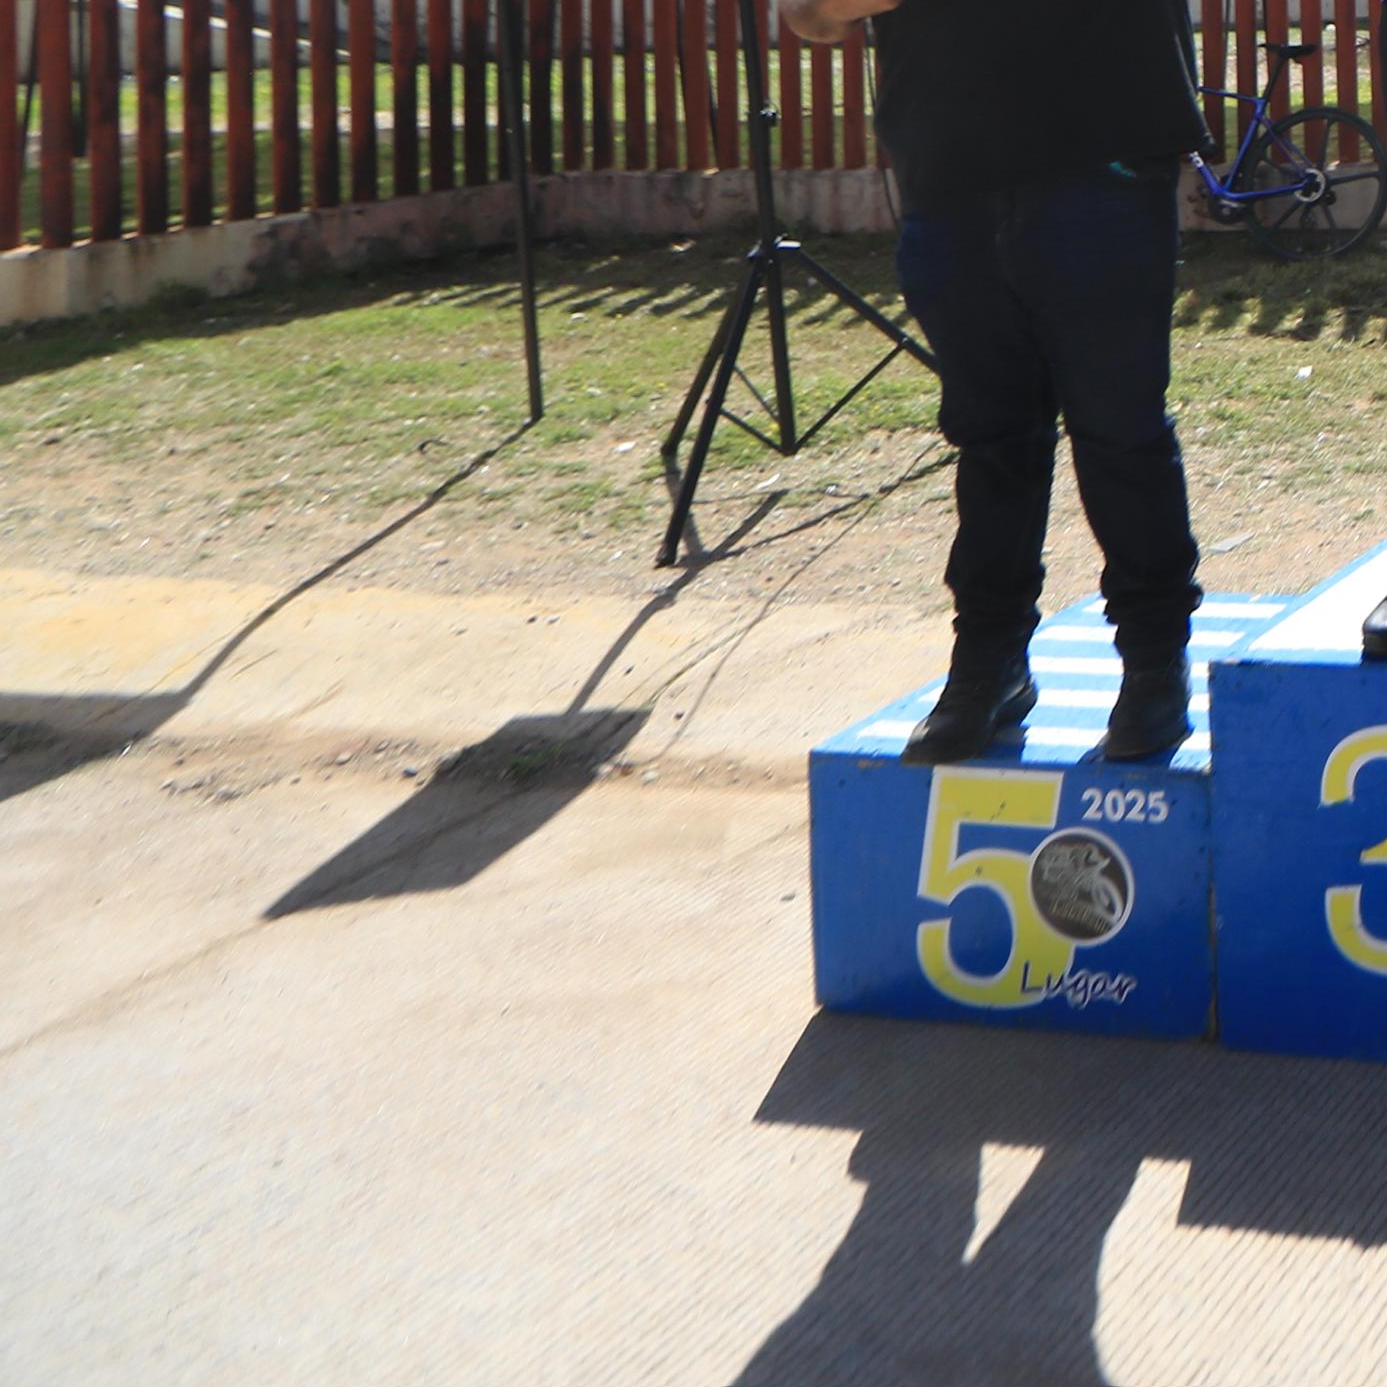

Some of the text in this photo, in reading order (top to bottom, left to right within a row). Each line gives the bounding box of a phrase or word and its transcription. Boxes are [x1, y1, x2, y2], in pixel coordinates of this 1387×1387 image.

[1081, 787, 1169, 823] 2025
[917, 765, 1084, 1008] 5
[1020, 960, 1137, 1009] Lugar
